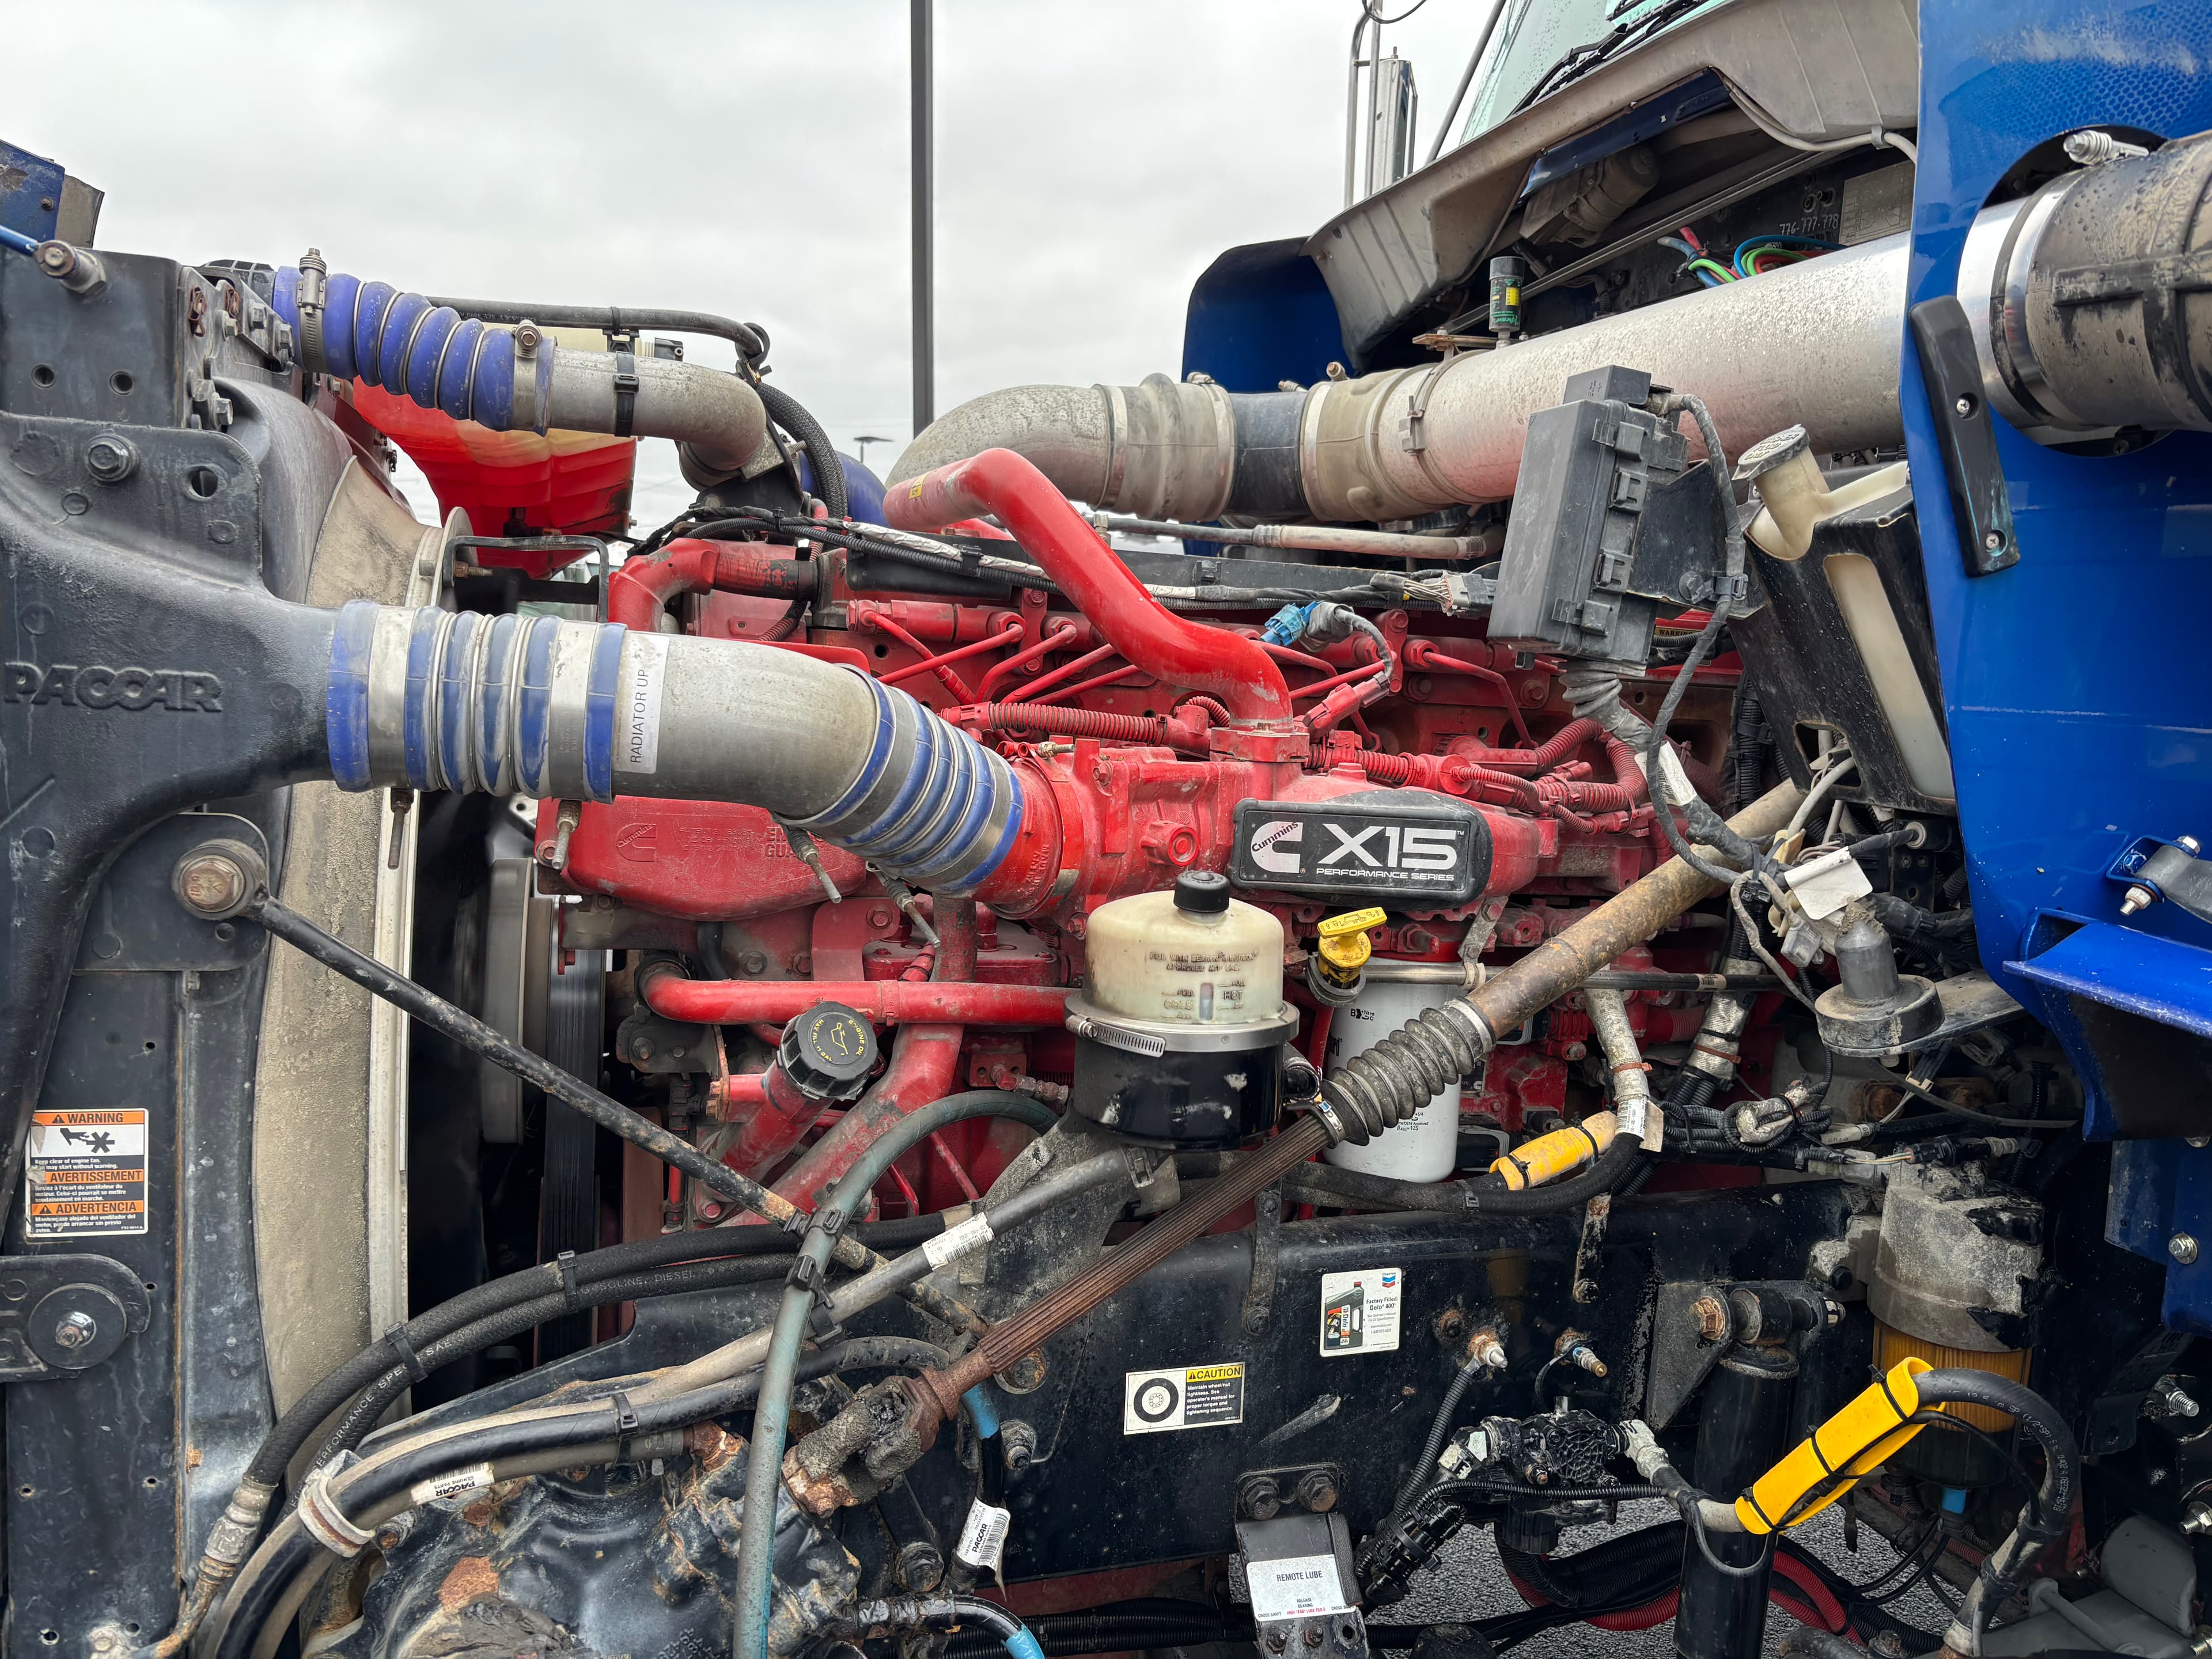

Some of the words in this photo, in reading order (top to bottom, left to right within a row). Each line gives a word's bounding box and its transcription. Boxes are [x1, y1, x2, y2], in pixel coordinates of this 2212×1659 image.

[637, 668, 648, 690] UP
[5, 661, 222, 713] PACCAR
[630, 691, 646, 764] RADIATOR
[616, 824, 654, 847] Cummins
[1251, 822, 1298, 852] Cummins
[1316, 868, 1408, 878] PERFORMANCE
[1411, 873, 1455, 881] SERIES
[1224, 990, 1244, 1001] HOT
[1164, 1000, 1194, 1011] COLD
[813, 1018, 824, 1031] MAX
[821, 1052, 832, 1061] GAL
[855, 1046, 864, 1055] OIL
[67, 1112, 124, 1123] WARNING
[50, 1171, 142, 1182] AVERTISSEMENT
[56, 1202, 137, 1214] ADVERTENCIA
[426, 1340, 453, 1356] SAE
[1197, 1367, 1240, 1379] CAUTION
[451, 1476, 474, 1485] GENUINE
[435, 1480, 475, 1497] PACCAR
[972, 1523, 988, 1552] PACCAR
[1277, 1573, 1304, 1582] REMOTE
[1305, 1570, 1323, 1580] LUBE
